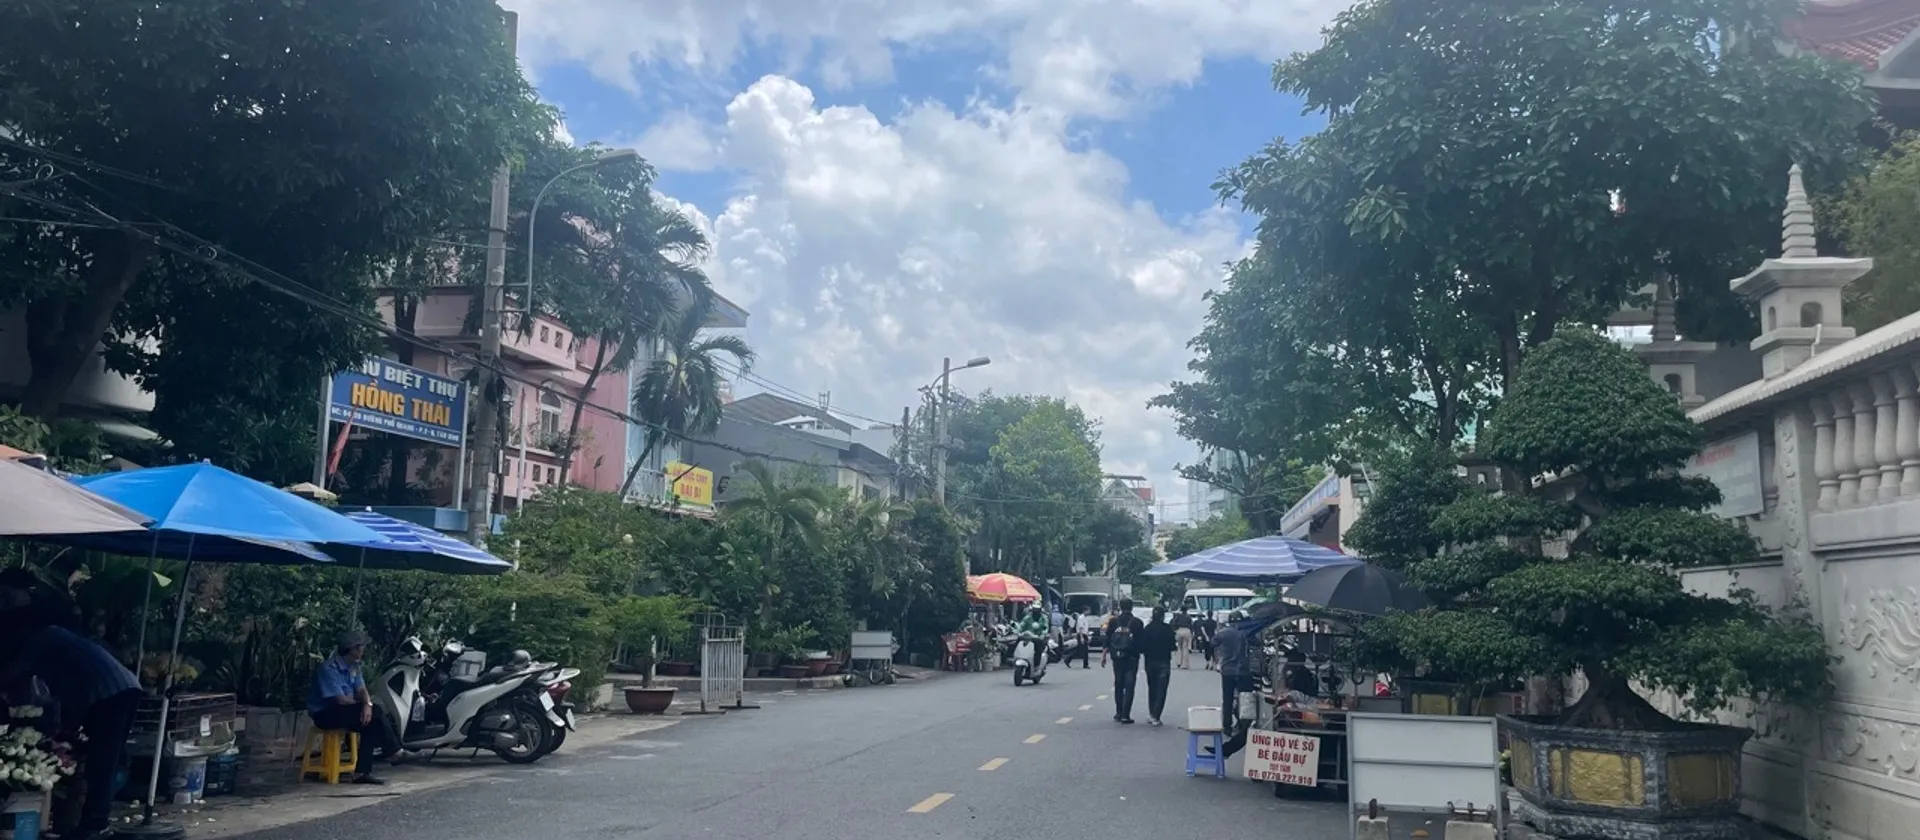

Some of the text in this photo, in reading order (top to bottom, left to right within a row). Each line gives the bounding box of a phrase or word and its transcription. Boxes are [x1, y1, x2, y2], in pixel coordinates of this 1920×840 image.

[384, 367, 424, 389] BIỆT
[351, 380, 451, 426] HỒNG THÁI
